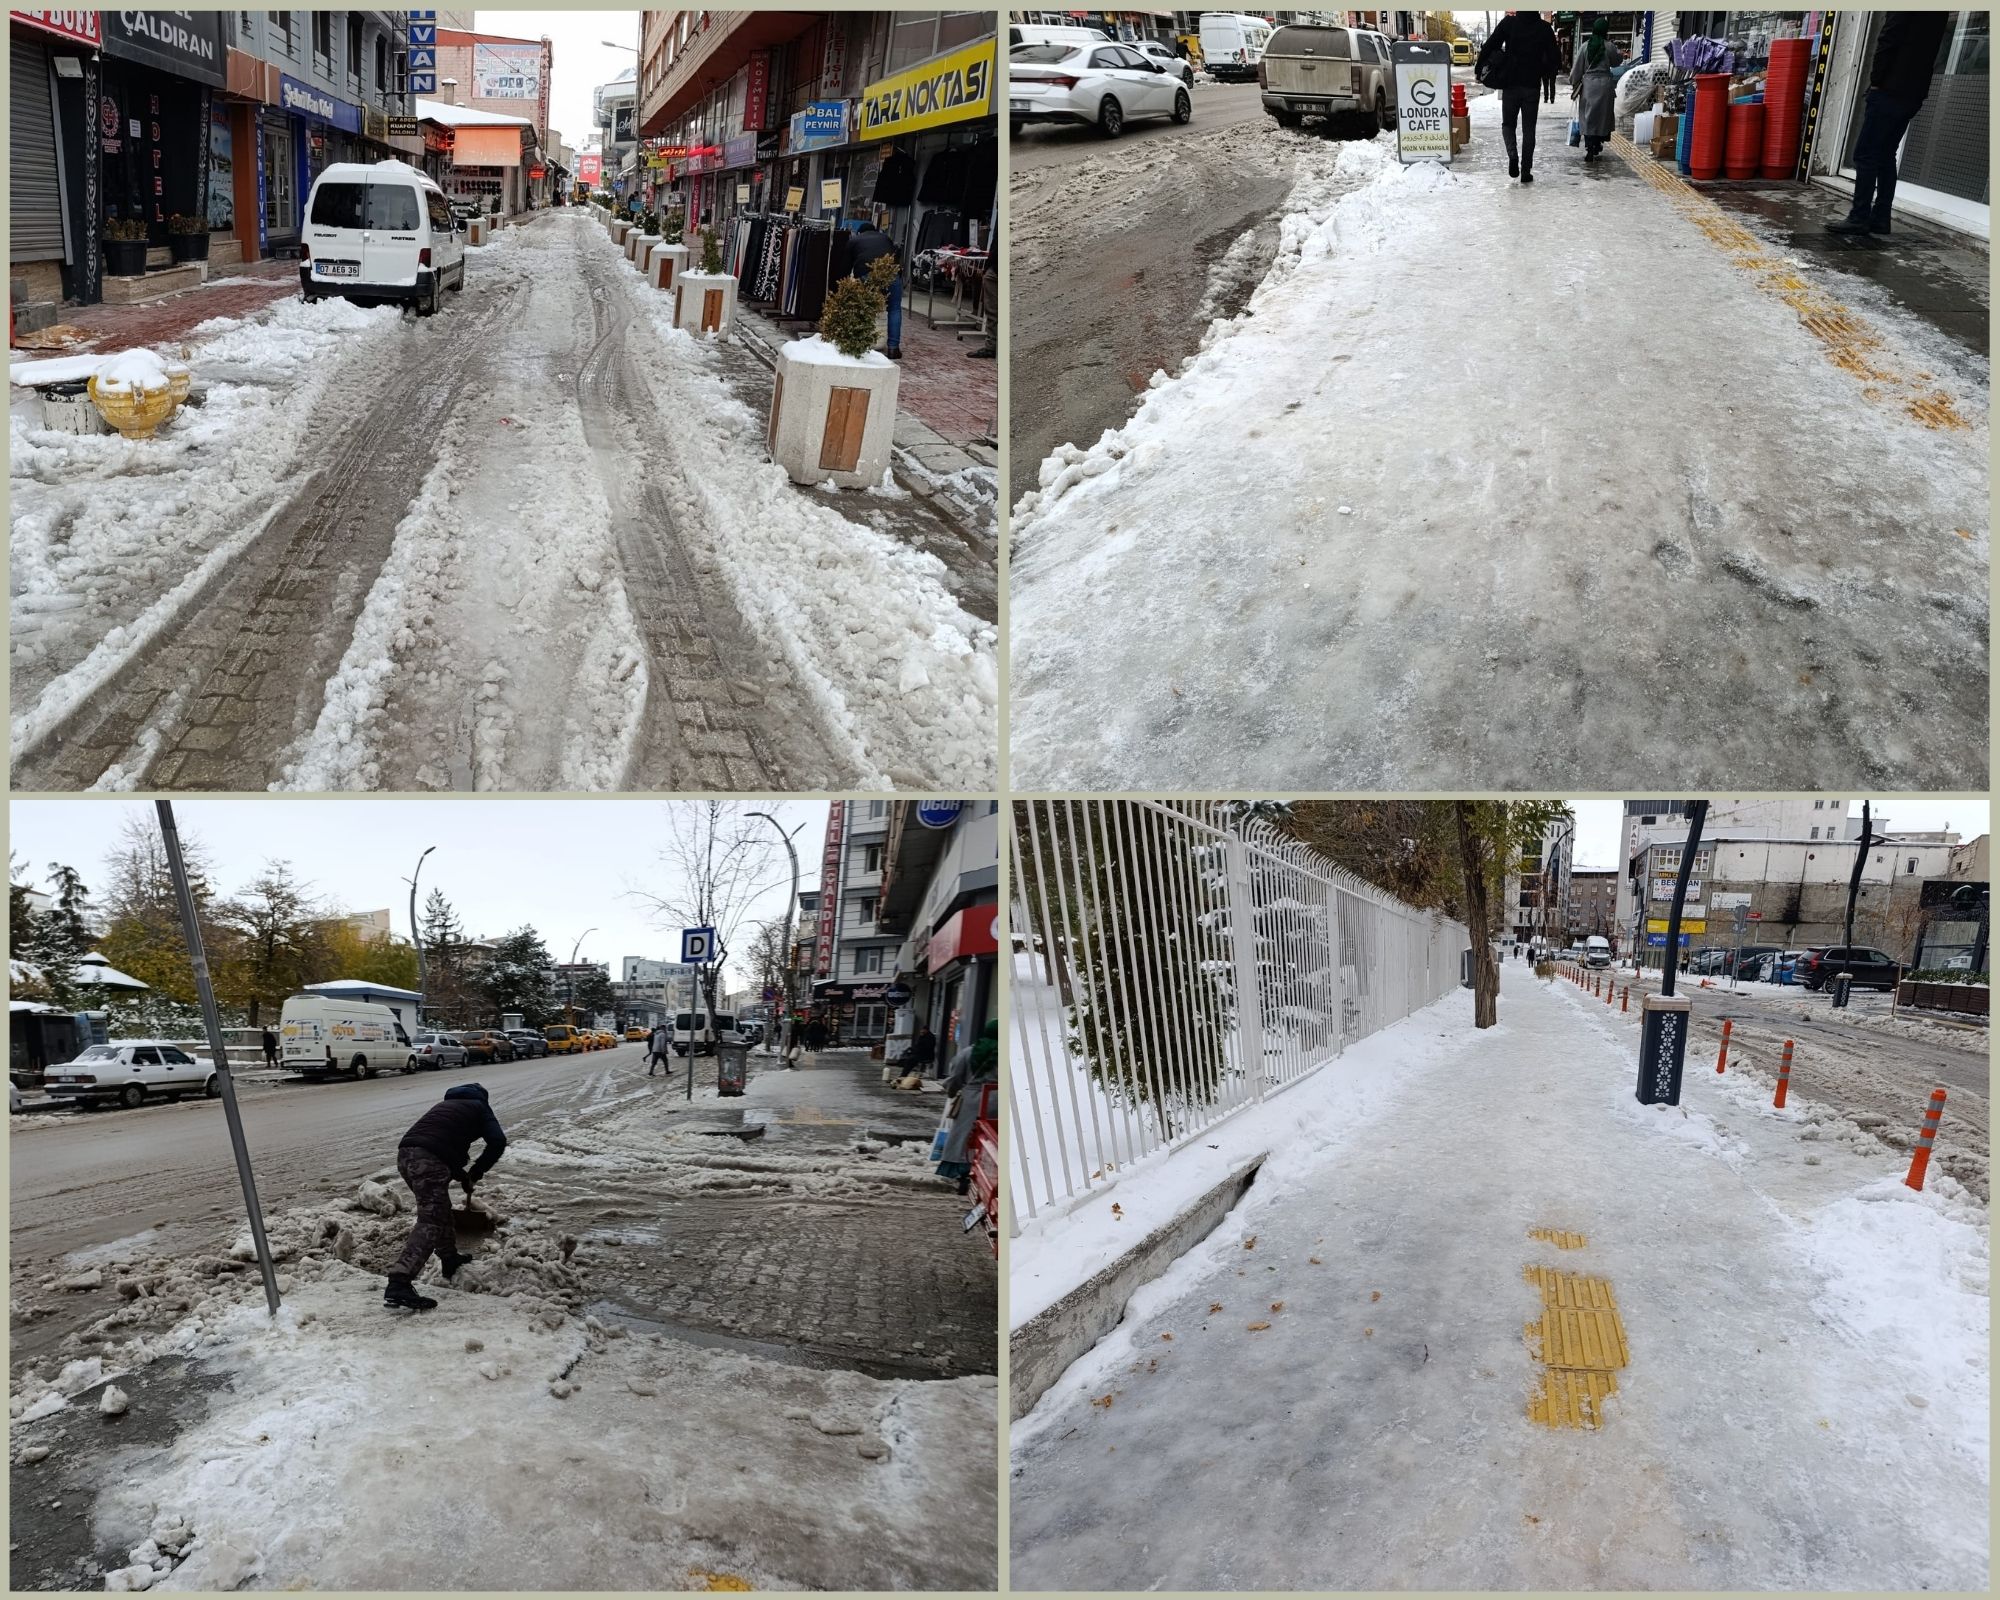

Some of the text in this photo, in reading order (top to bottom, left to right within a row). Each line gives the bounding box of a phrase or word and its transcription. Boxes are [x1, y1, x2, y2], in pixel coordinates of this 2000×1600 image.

[120, 11, 213, 60] ÇALDIRAN
[412, 27, 433, 91] VAN
[865, 89, 903, 128] TARZ
[904, 59, 990, 119] NOKTASI
[816, 108, 841, 118] BAL
[1400, 107, 1448, 119] LONDRA
[805, 120, 840, 129] PEYNİR
[1408, 119, 1441, 131] CAFE
[1801, 108, 1817, 169] OTEL
[150, 94, 164, 222] HOTEL
[320, 264, 358, 274] 07 AEG 36
[690, 936, 705, 955] D
